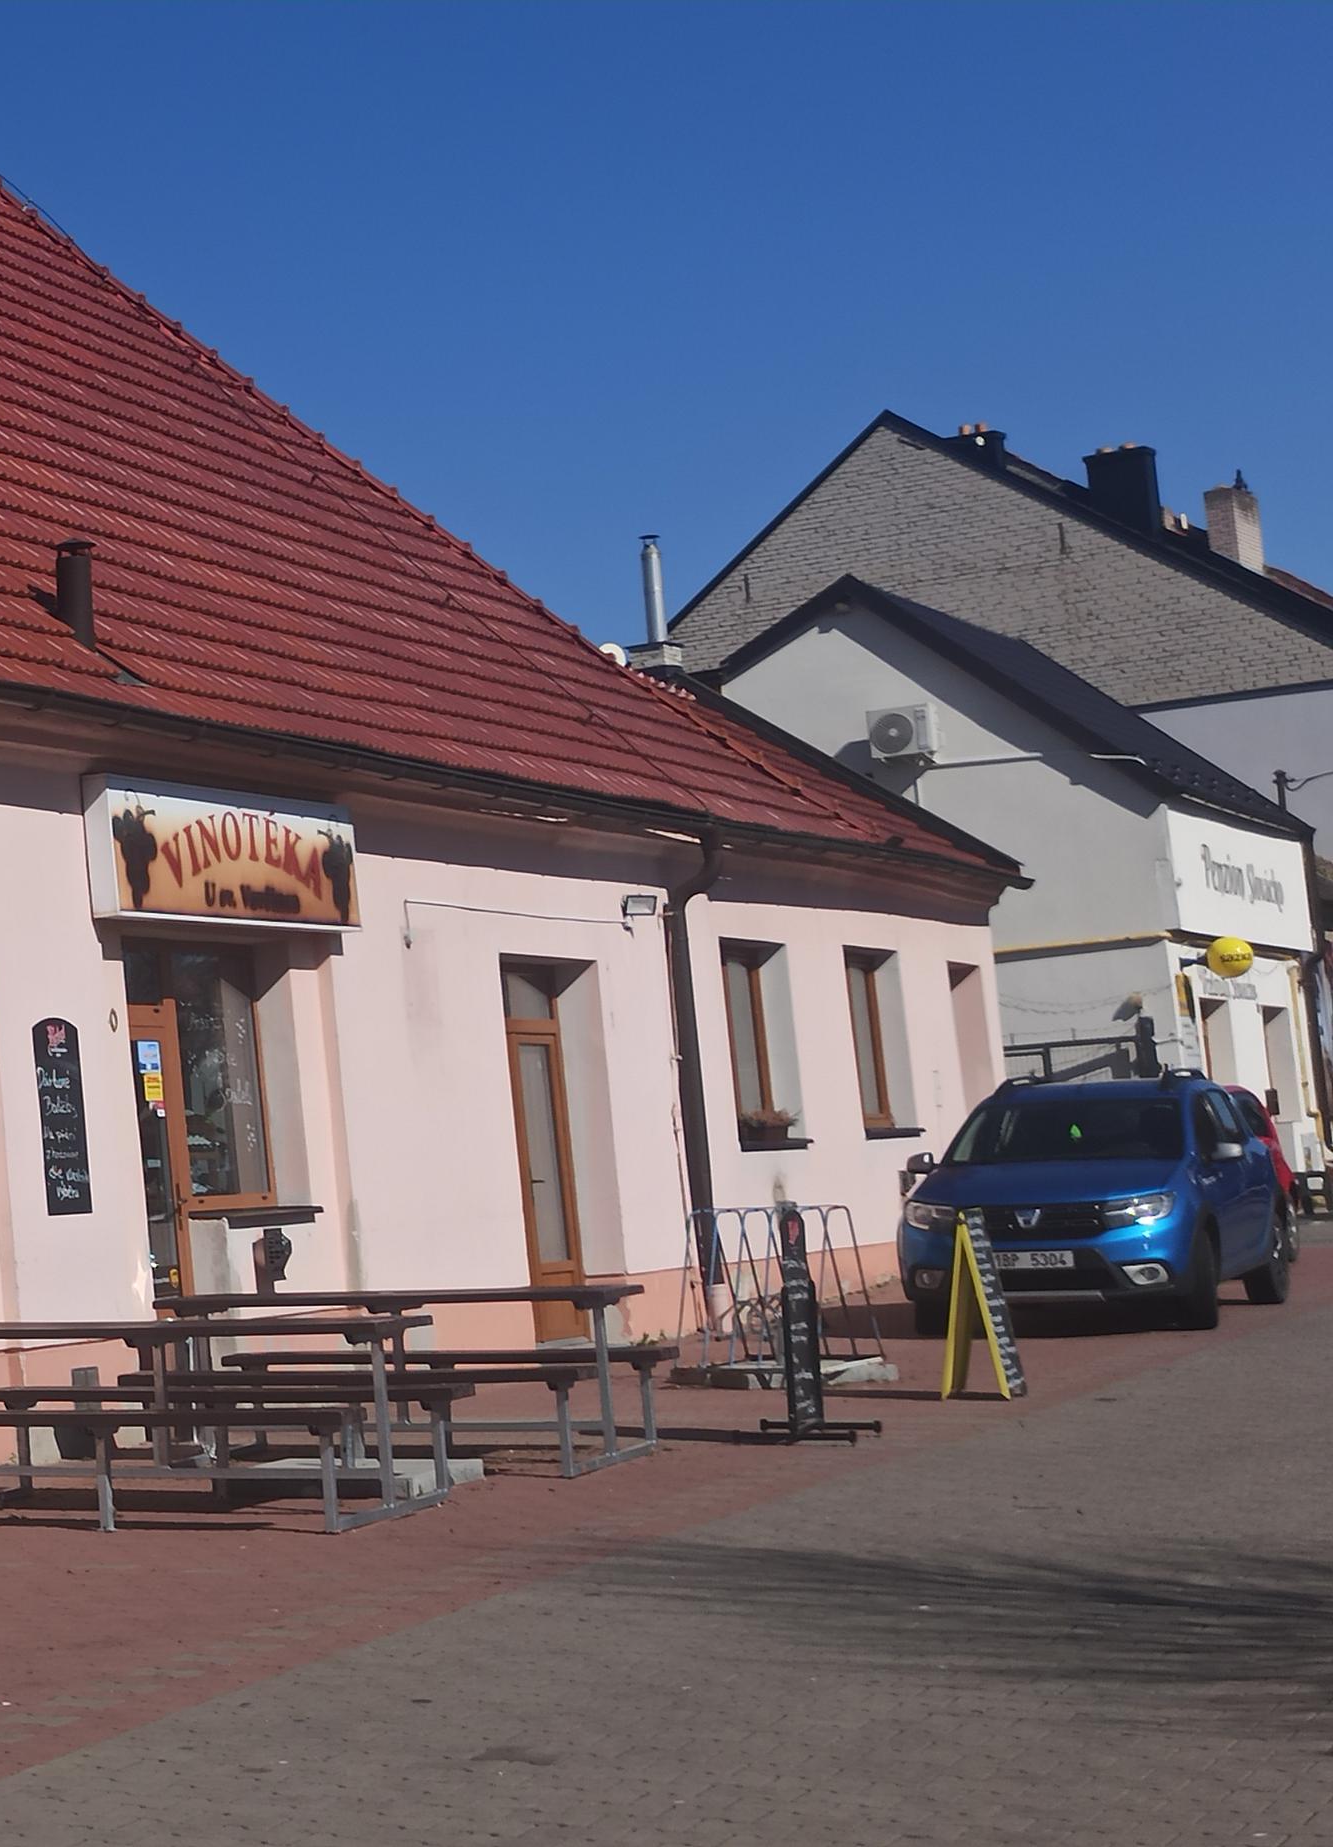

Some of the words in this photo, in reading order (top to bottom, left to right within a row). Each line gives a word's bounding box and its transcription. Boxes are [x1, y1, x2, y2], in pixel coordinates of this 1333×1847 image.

[161, 810, 323, 900] VINOTÉKA
[204, 881, 216, 907] U
[995, 1253, 1020, 1267] 1BP
[1029, 1252, 1067, 1267] 5304
